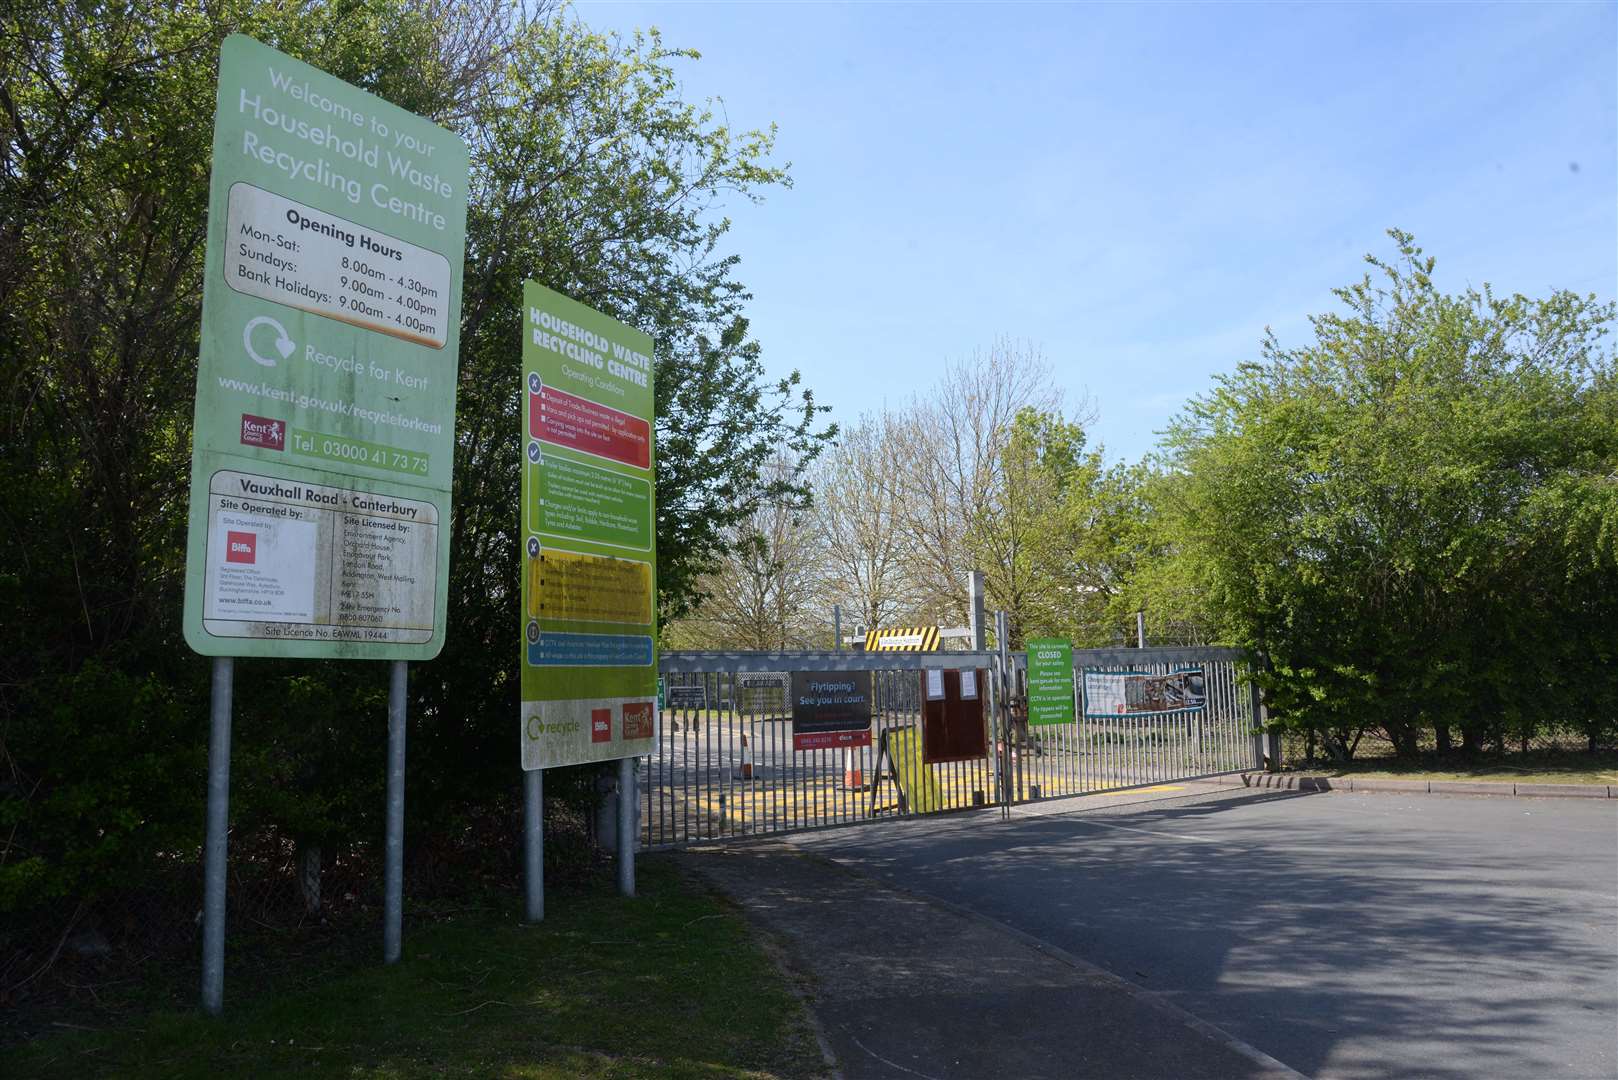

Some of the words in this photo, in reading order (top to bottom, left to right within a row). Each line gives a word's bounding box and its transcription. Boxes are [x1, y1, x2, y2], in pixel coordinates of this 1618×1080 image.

[269, 67, 364, 127] Welcome
[371, 118, 388, 137] to
[394, 127, 436, 157] your
[239, 88, 379, 169] Household
[387, 152, 453, 199] Waste
[243, 131, 362, 204] Recycling
[371, 184, 446, 231] Centre
[286, 209, 355, 248] Opening
[360, 234, 403, 261] Hours
[240, 223, 301, 253] Mon-Sat:
[341, 257, 386, 281] 8.00am
[396, 271, 438, 299] 4.30pm
[239, 243, 298, 273] Sundays:
[340, 275, 385, 300] 9.00am
[395, 291, 437, 318] 4.00pm
[238, 265, 272, 285] Bank
[275, 275, 332, 304] Holidays:
[338, 295, 384, 319] 9.00am
[395, 310, 436, 336] 4.00pm
[530, 306, 609, 354] HOUSEHOLD
[612, 341, 650, 371] WASTE
[305, 345, 364, 375] Recycle
[368, 361, 390, 381] for
[395, 367, 428, 392] Kent
[533, 328, 604, 369] RECYCLING
[607, 359, 648, 388] CENTRE
[218, 375, 442, 435] www.kent.gov.uk/recycleforkent
[244, 420, 267, 434] Kent
[323, 439, 367, 462] 03000
[372, 450, 387, 465] 41
[392, 455, 408, 469] 73
[412, 458, 428, 472] 73
[220, 499, 239, 510] Site
[241, 502, 287, 517] Operated
[289, 508, 303, 520] by:
[240, 478, 301, 500] Vauxhall
[306, 489, 338, 505] Road
[352, 496, 418, 519] Canterbury
[236, 518, 263, 528] Operated
[344, 516, 360, 526] Site
[362, 518, 396, 531] Licensed
[398, 524, 410, 534] by:
[344, 529, 382, 540] Environment
[231, 542, 252, 553] Biffa
[265, 626, 281, 636] Site
[283, 628, 313, 637] Licence
[1037, 651, 1062, 659] CLOSED
[799, 696, 815, 705] See
[816, 696, 833, 706] you
[844, 695, 864, 703] court
[810, 681, 856, 692] Flytipping?
[546, 720, 580, 736] recycle
